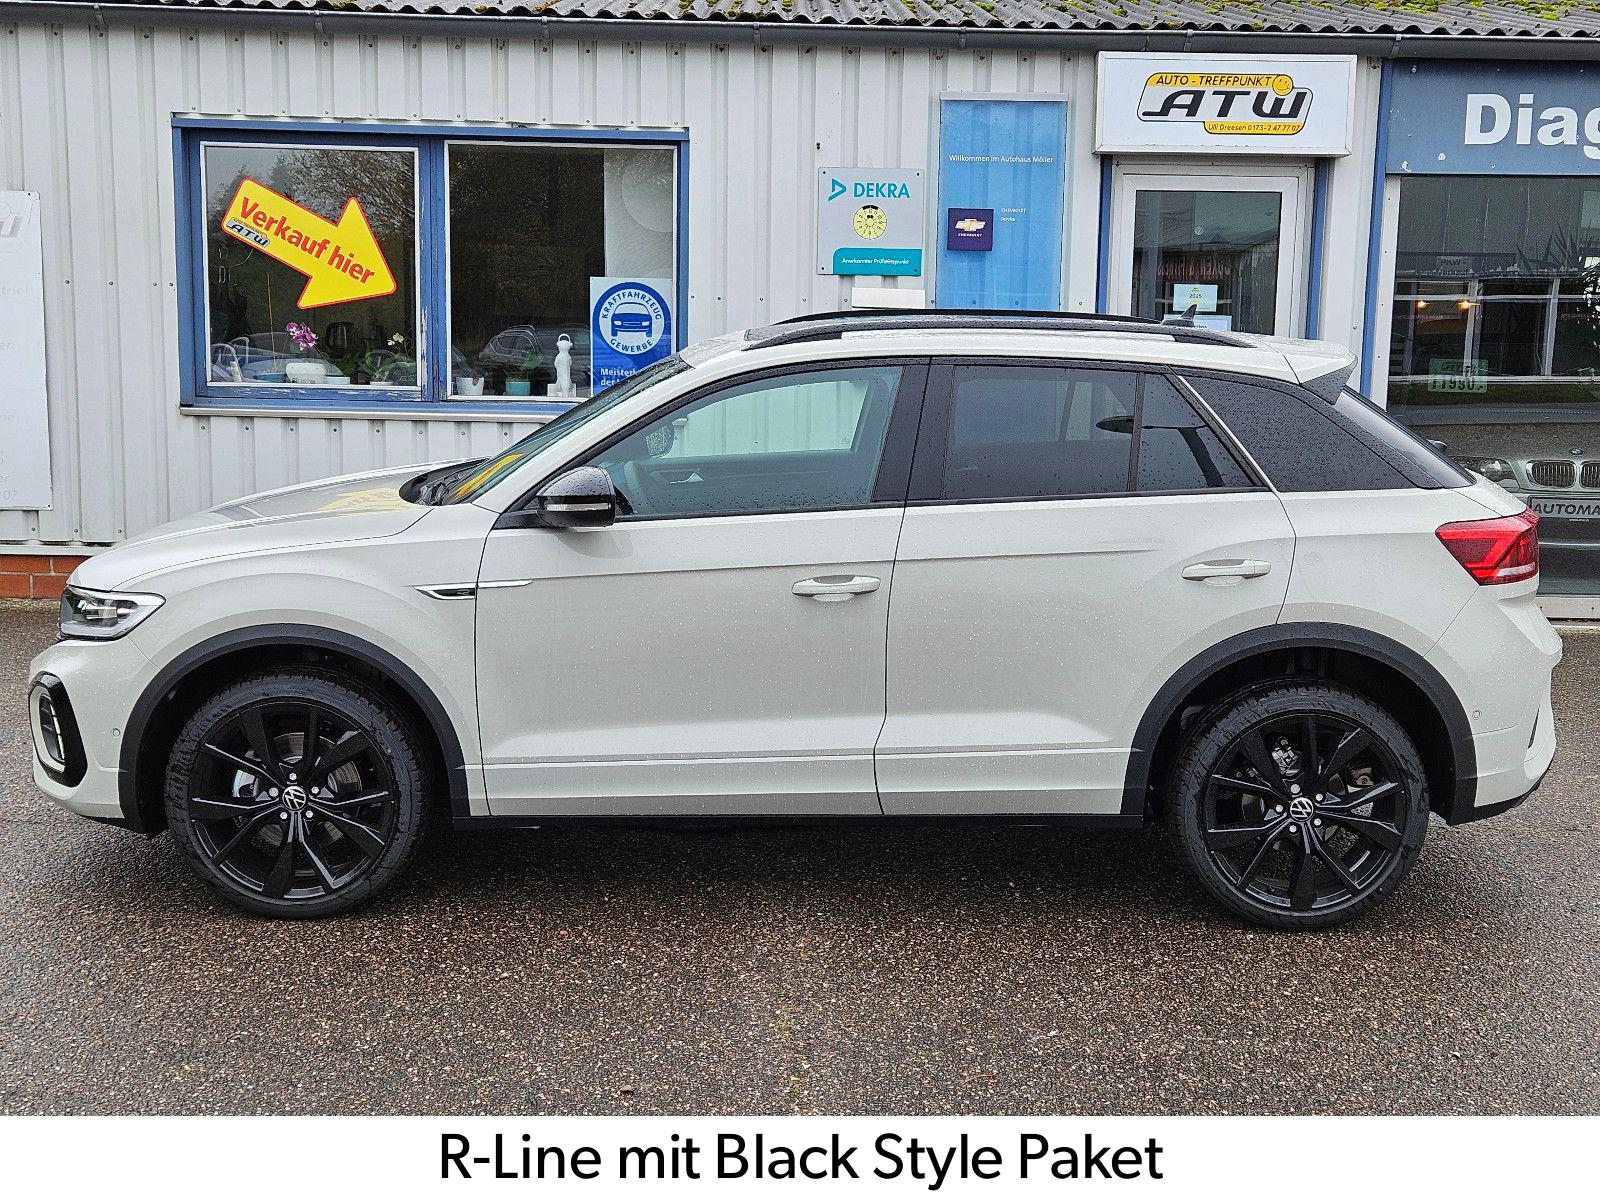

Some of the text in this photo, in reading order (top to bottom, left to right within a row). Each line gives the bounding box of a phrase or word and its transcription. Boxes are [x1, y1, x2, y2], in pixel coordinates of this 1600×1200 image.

[1155, 75, 1189, 86] AUTO
[1198, 75, 1273, 87] TREFFPUNKT
[1141, 89, 1308, 119] ATW
[948, 154, 990, 162] Willkommen
[1000, 155, 1032, 163] Autohaus
[853, 182, 911, 199] DEKRA
[239, 196, 375, 284] Verkauf hier
[841, 257, 873, 265] Anerkannter
[601, 291, 662, 321] KRAFTFAHRZEUG
[610, 338, 654, 353] GEWERBE
